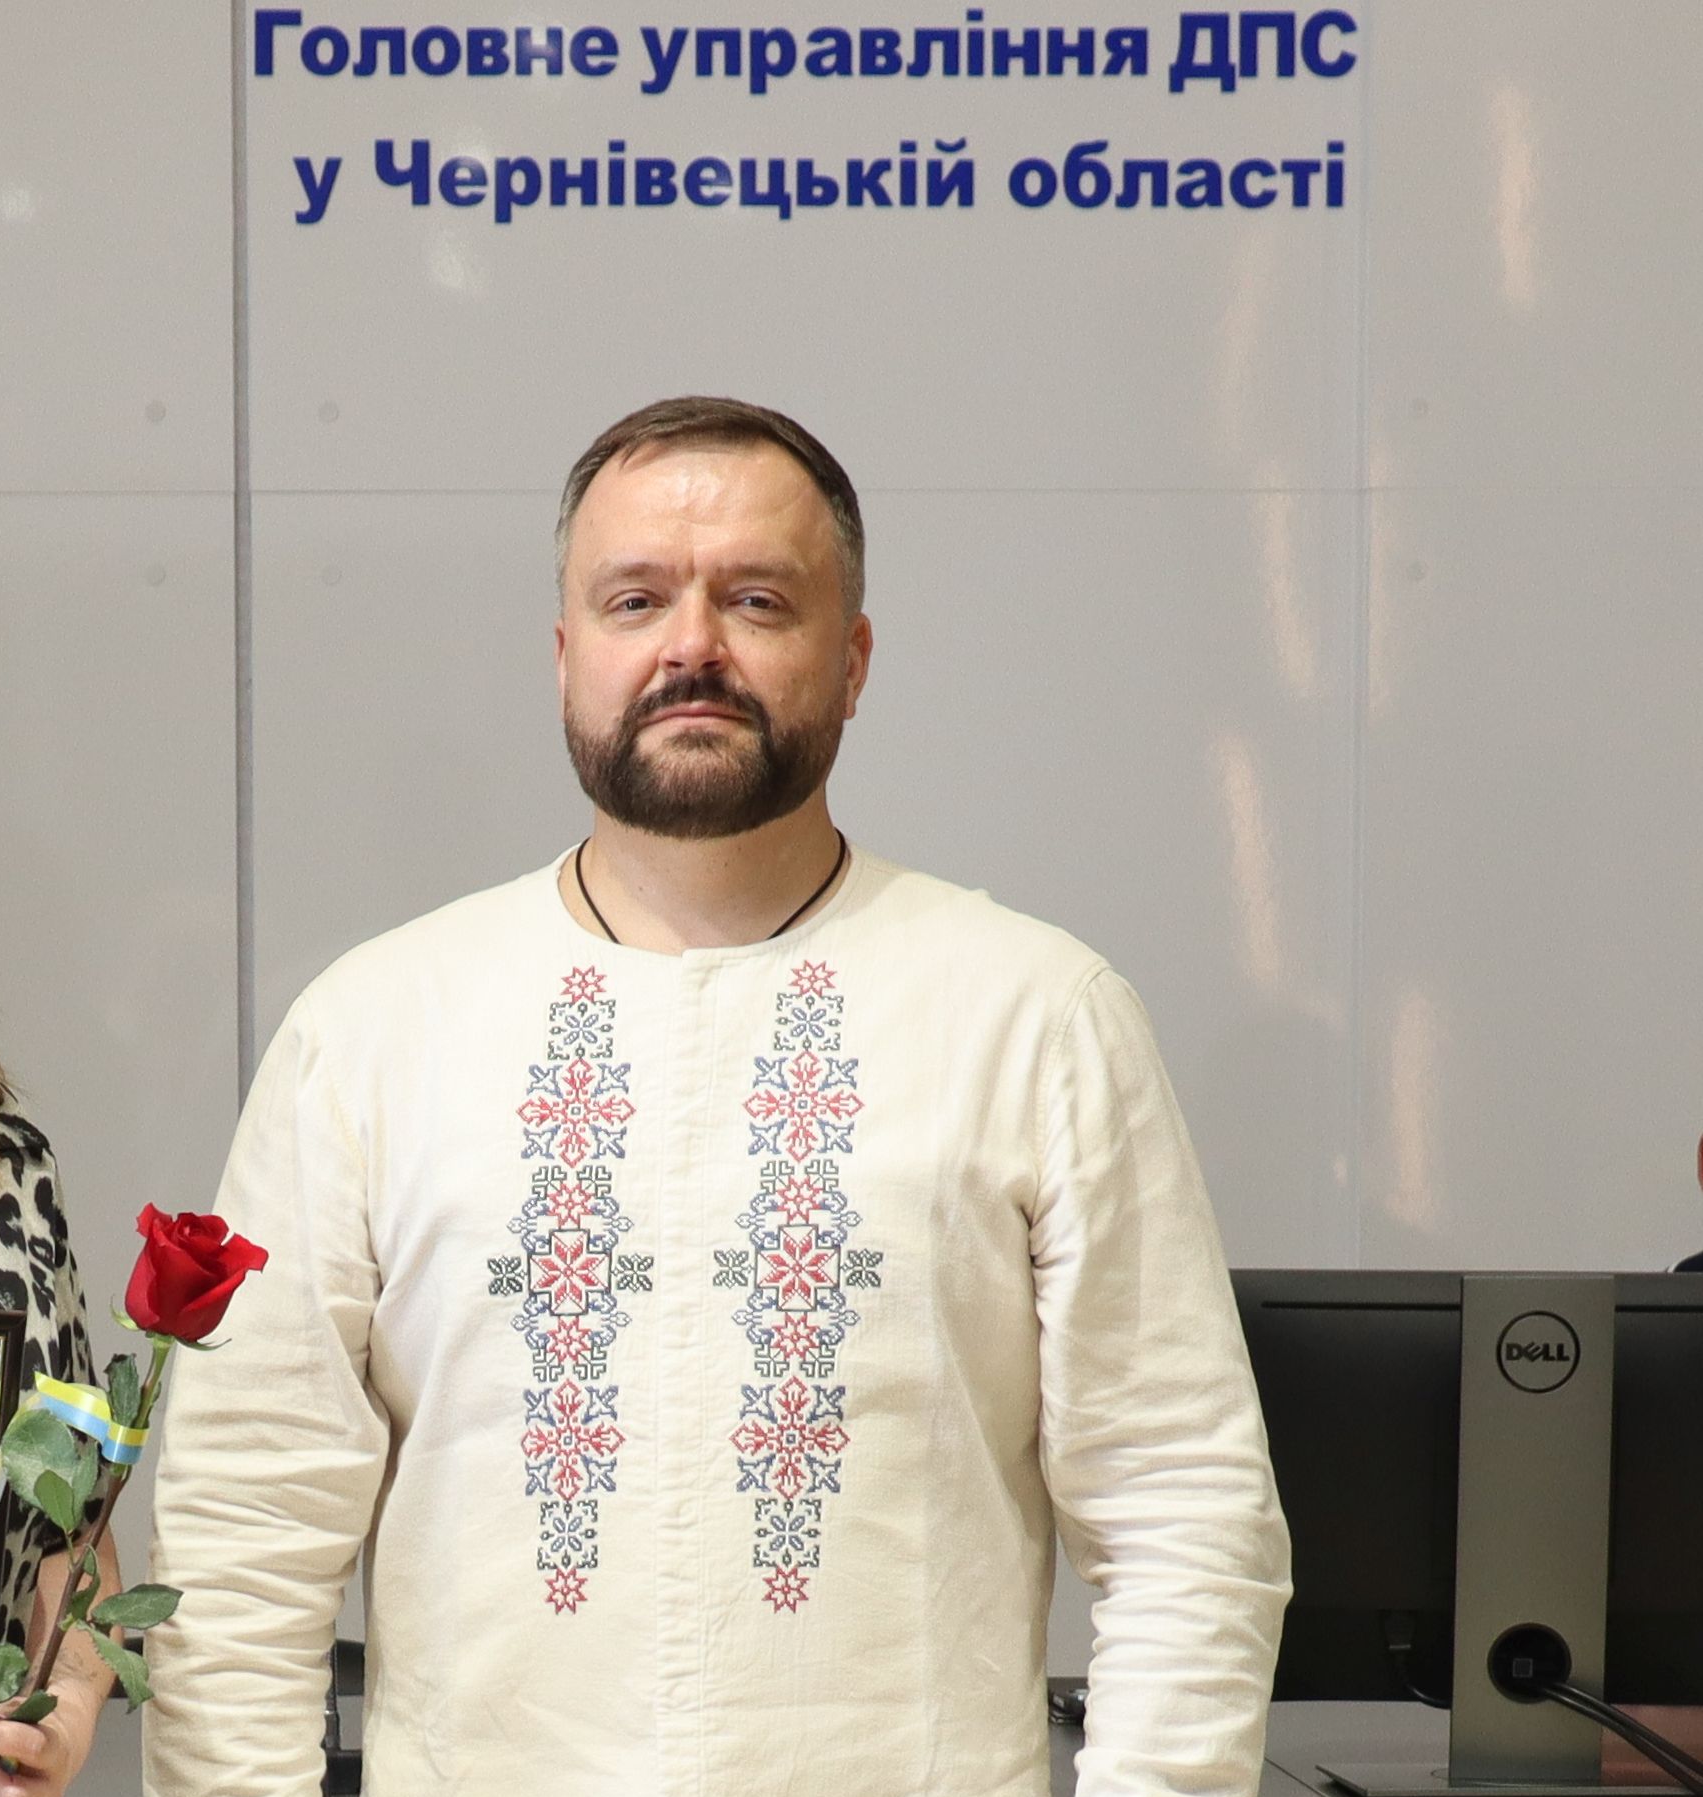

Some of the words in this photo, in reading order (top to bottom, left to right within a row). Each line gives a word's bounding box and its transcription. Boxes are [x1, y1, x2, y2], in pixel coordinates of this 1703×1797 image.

[254, 10, 618, 77] Головне
[641, 9, 1148, 96] управління
[1170, 10, 1358, 93] ДПС
[295, 158, 341, 225] у
[375, 139, 975, 224] Чернівецькій
[1009, 140, 1345, 209] області
[1505, 1342, 1570, 1362] DELL
